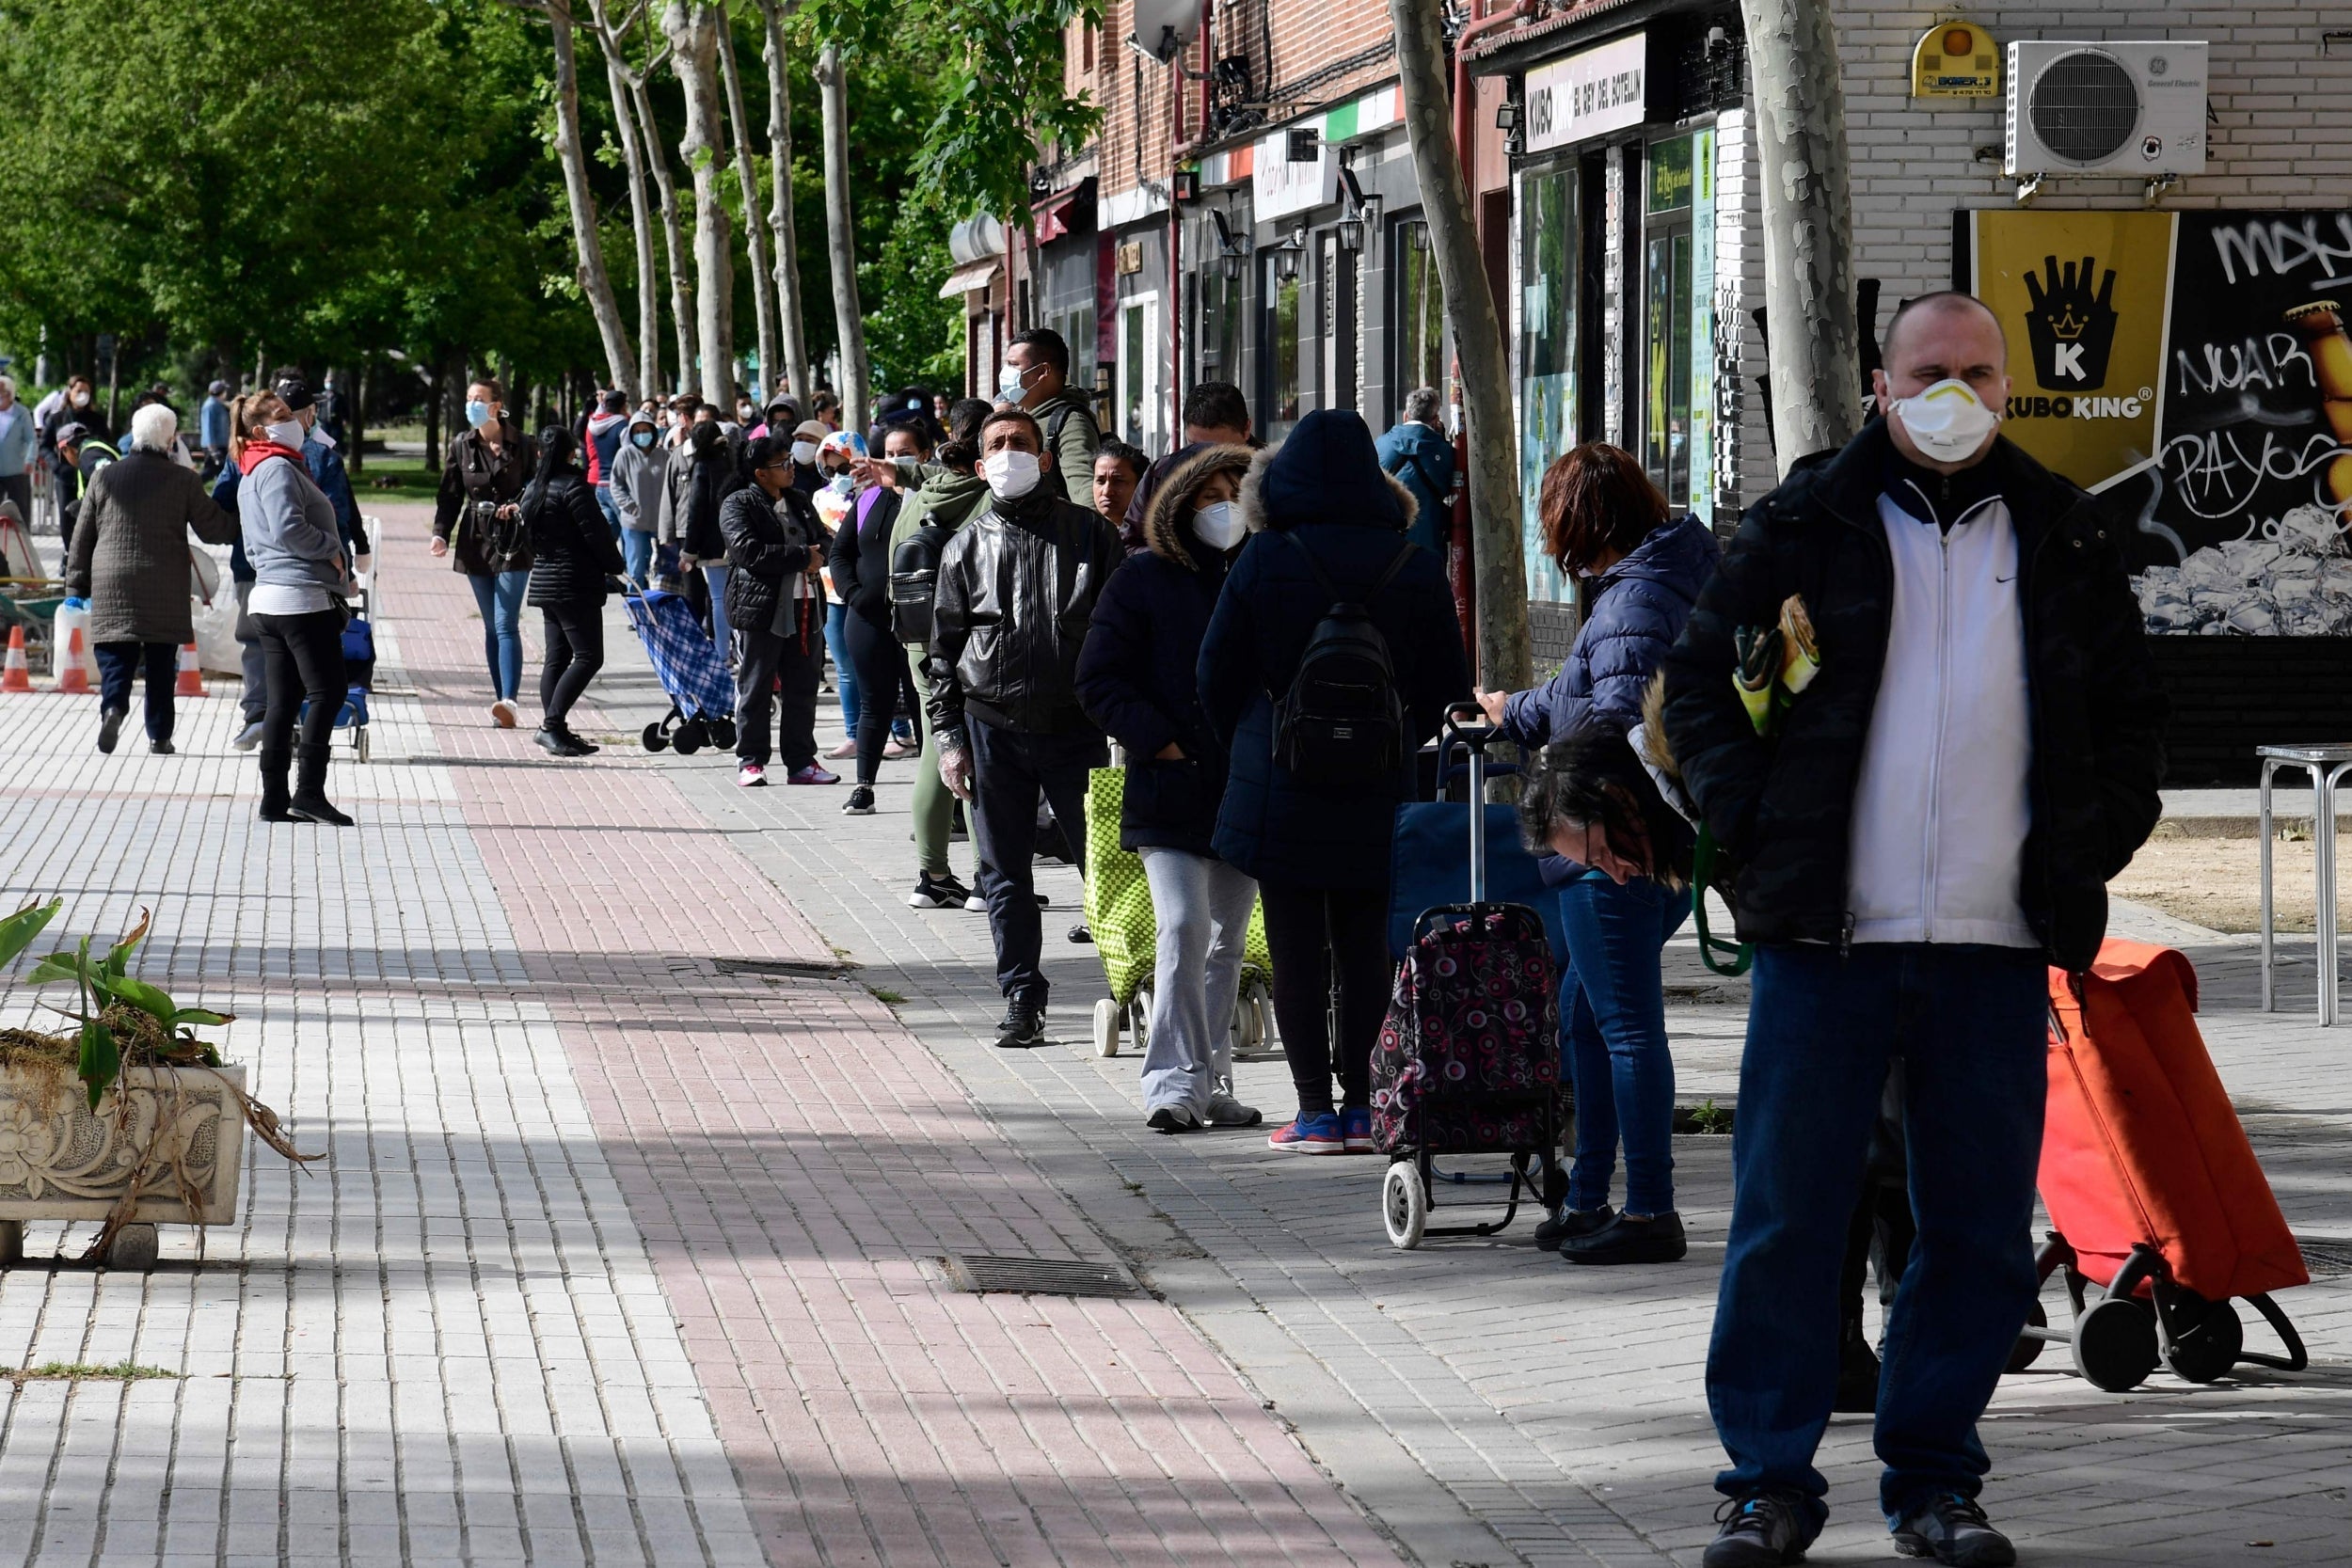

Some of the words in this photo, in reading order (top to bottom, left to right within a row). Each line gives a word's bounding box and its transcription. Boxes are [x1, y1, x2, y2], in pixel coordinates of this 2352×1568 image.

[1574, 87, 1581, 118] EL
[1583, 82, 1596, 118] REY
[1597, 77, 1609, 111] DEL
[1612, 69, 1641, 106] BOTELLIN
[2148, 79, 2174, 87] General
[2174, 79, 2201, 87] Electric
[2055, 341, 2087, 382] K
